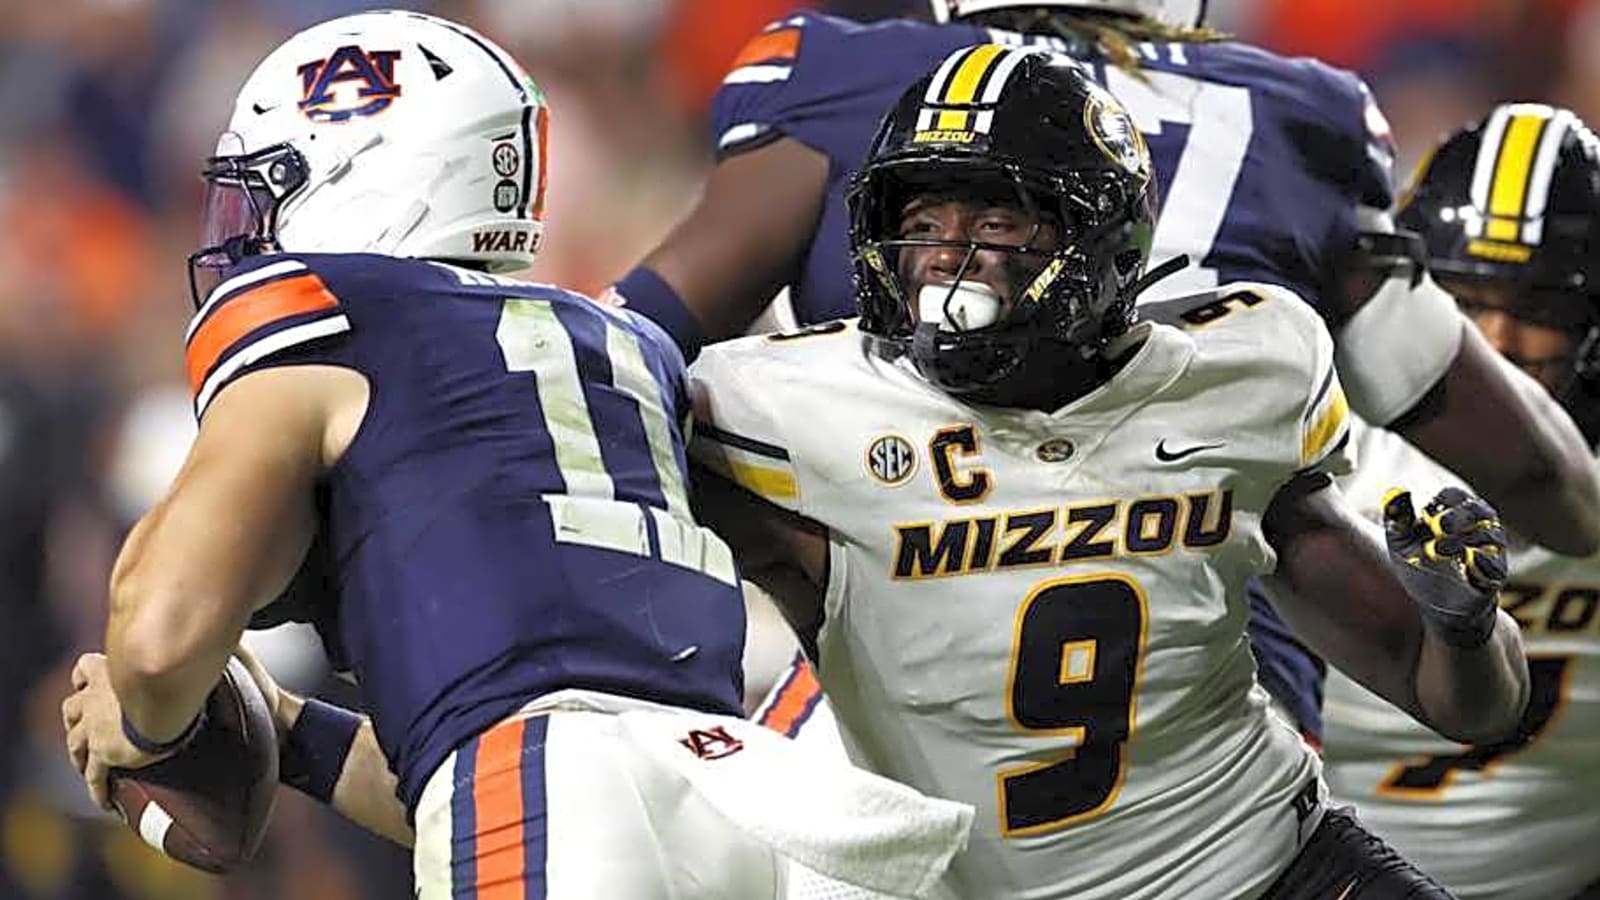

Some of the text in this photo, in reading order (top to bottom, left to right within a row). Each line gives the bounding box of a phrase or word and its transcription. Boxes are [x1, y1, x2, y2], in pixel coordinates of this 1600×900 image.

[913, 130, 976, 144] MIZZOU
[472, 231, 528, 253] WAR
[495, 298, 738, 588] 11
[867, 435, 918, 485] SEC
[929, 423, 993, 506] C
[891, 487, 1234, 581] MIZZOU
[997, 571, 1149, 839] 9
